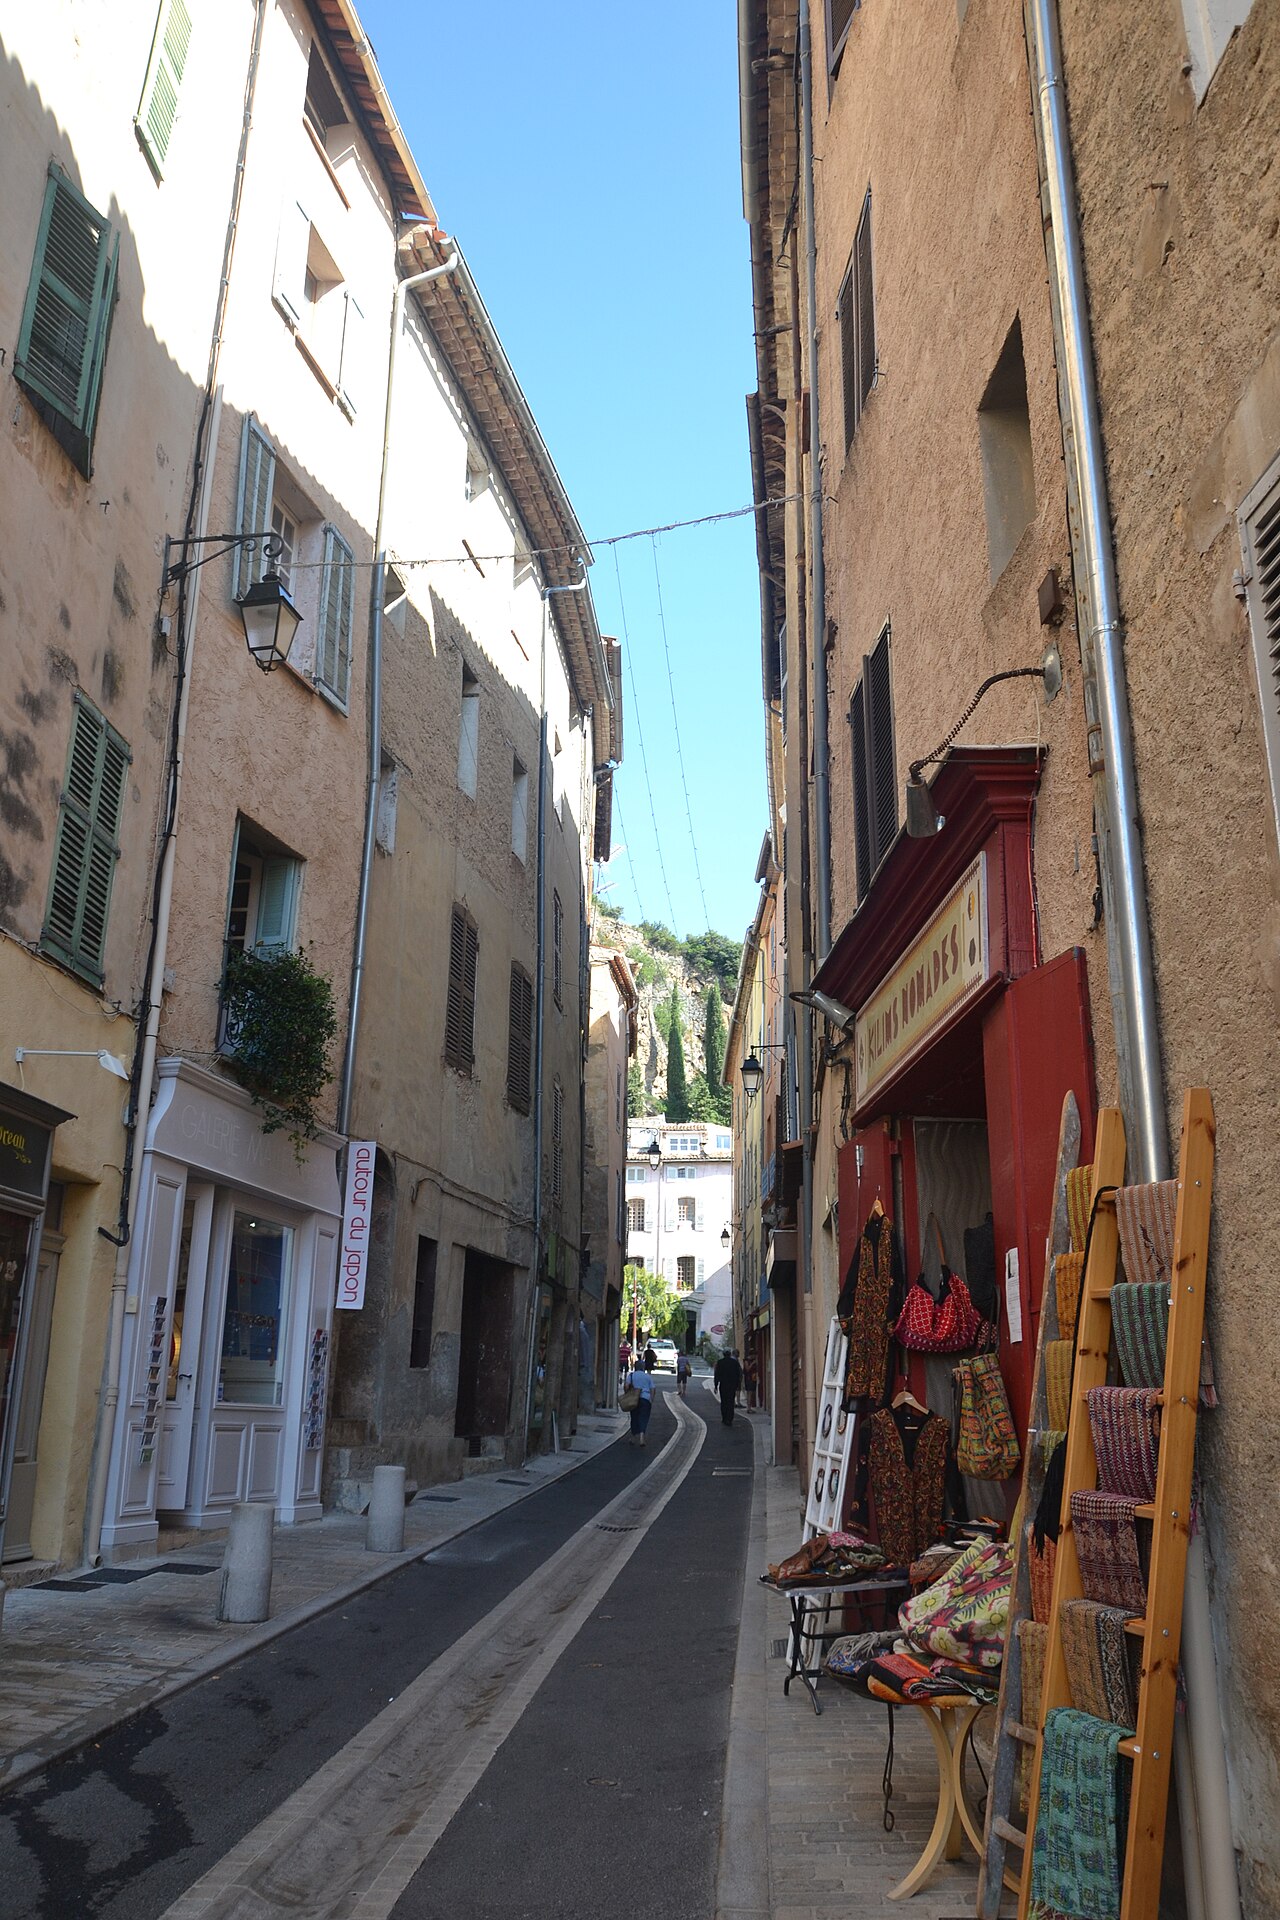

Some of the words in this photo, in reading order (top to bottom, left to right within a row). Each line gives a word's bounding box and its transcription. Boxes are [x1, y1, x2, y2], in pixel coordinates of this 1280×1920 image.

[867, 997, 899, 1067] KILIMS
[901, 924, 959, 1030] NOMADES
[181, 1104, 241, 1158] GALERIE
[352, 1148, 372, 1212] autour
[349, 1217, 368, 1240] du
[342, 1246, 365, 1303] japon
